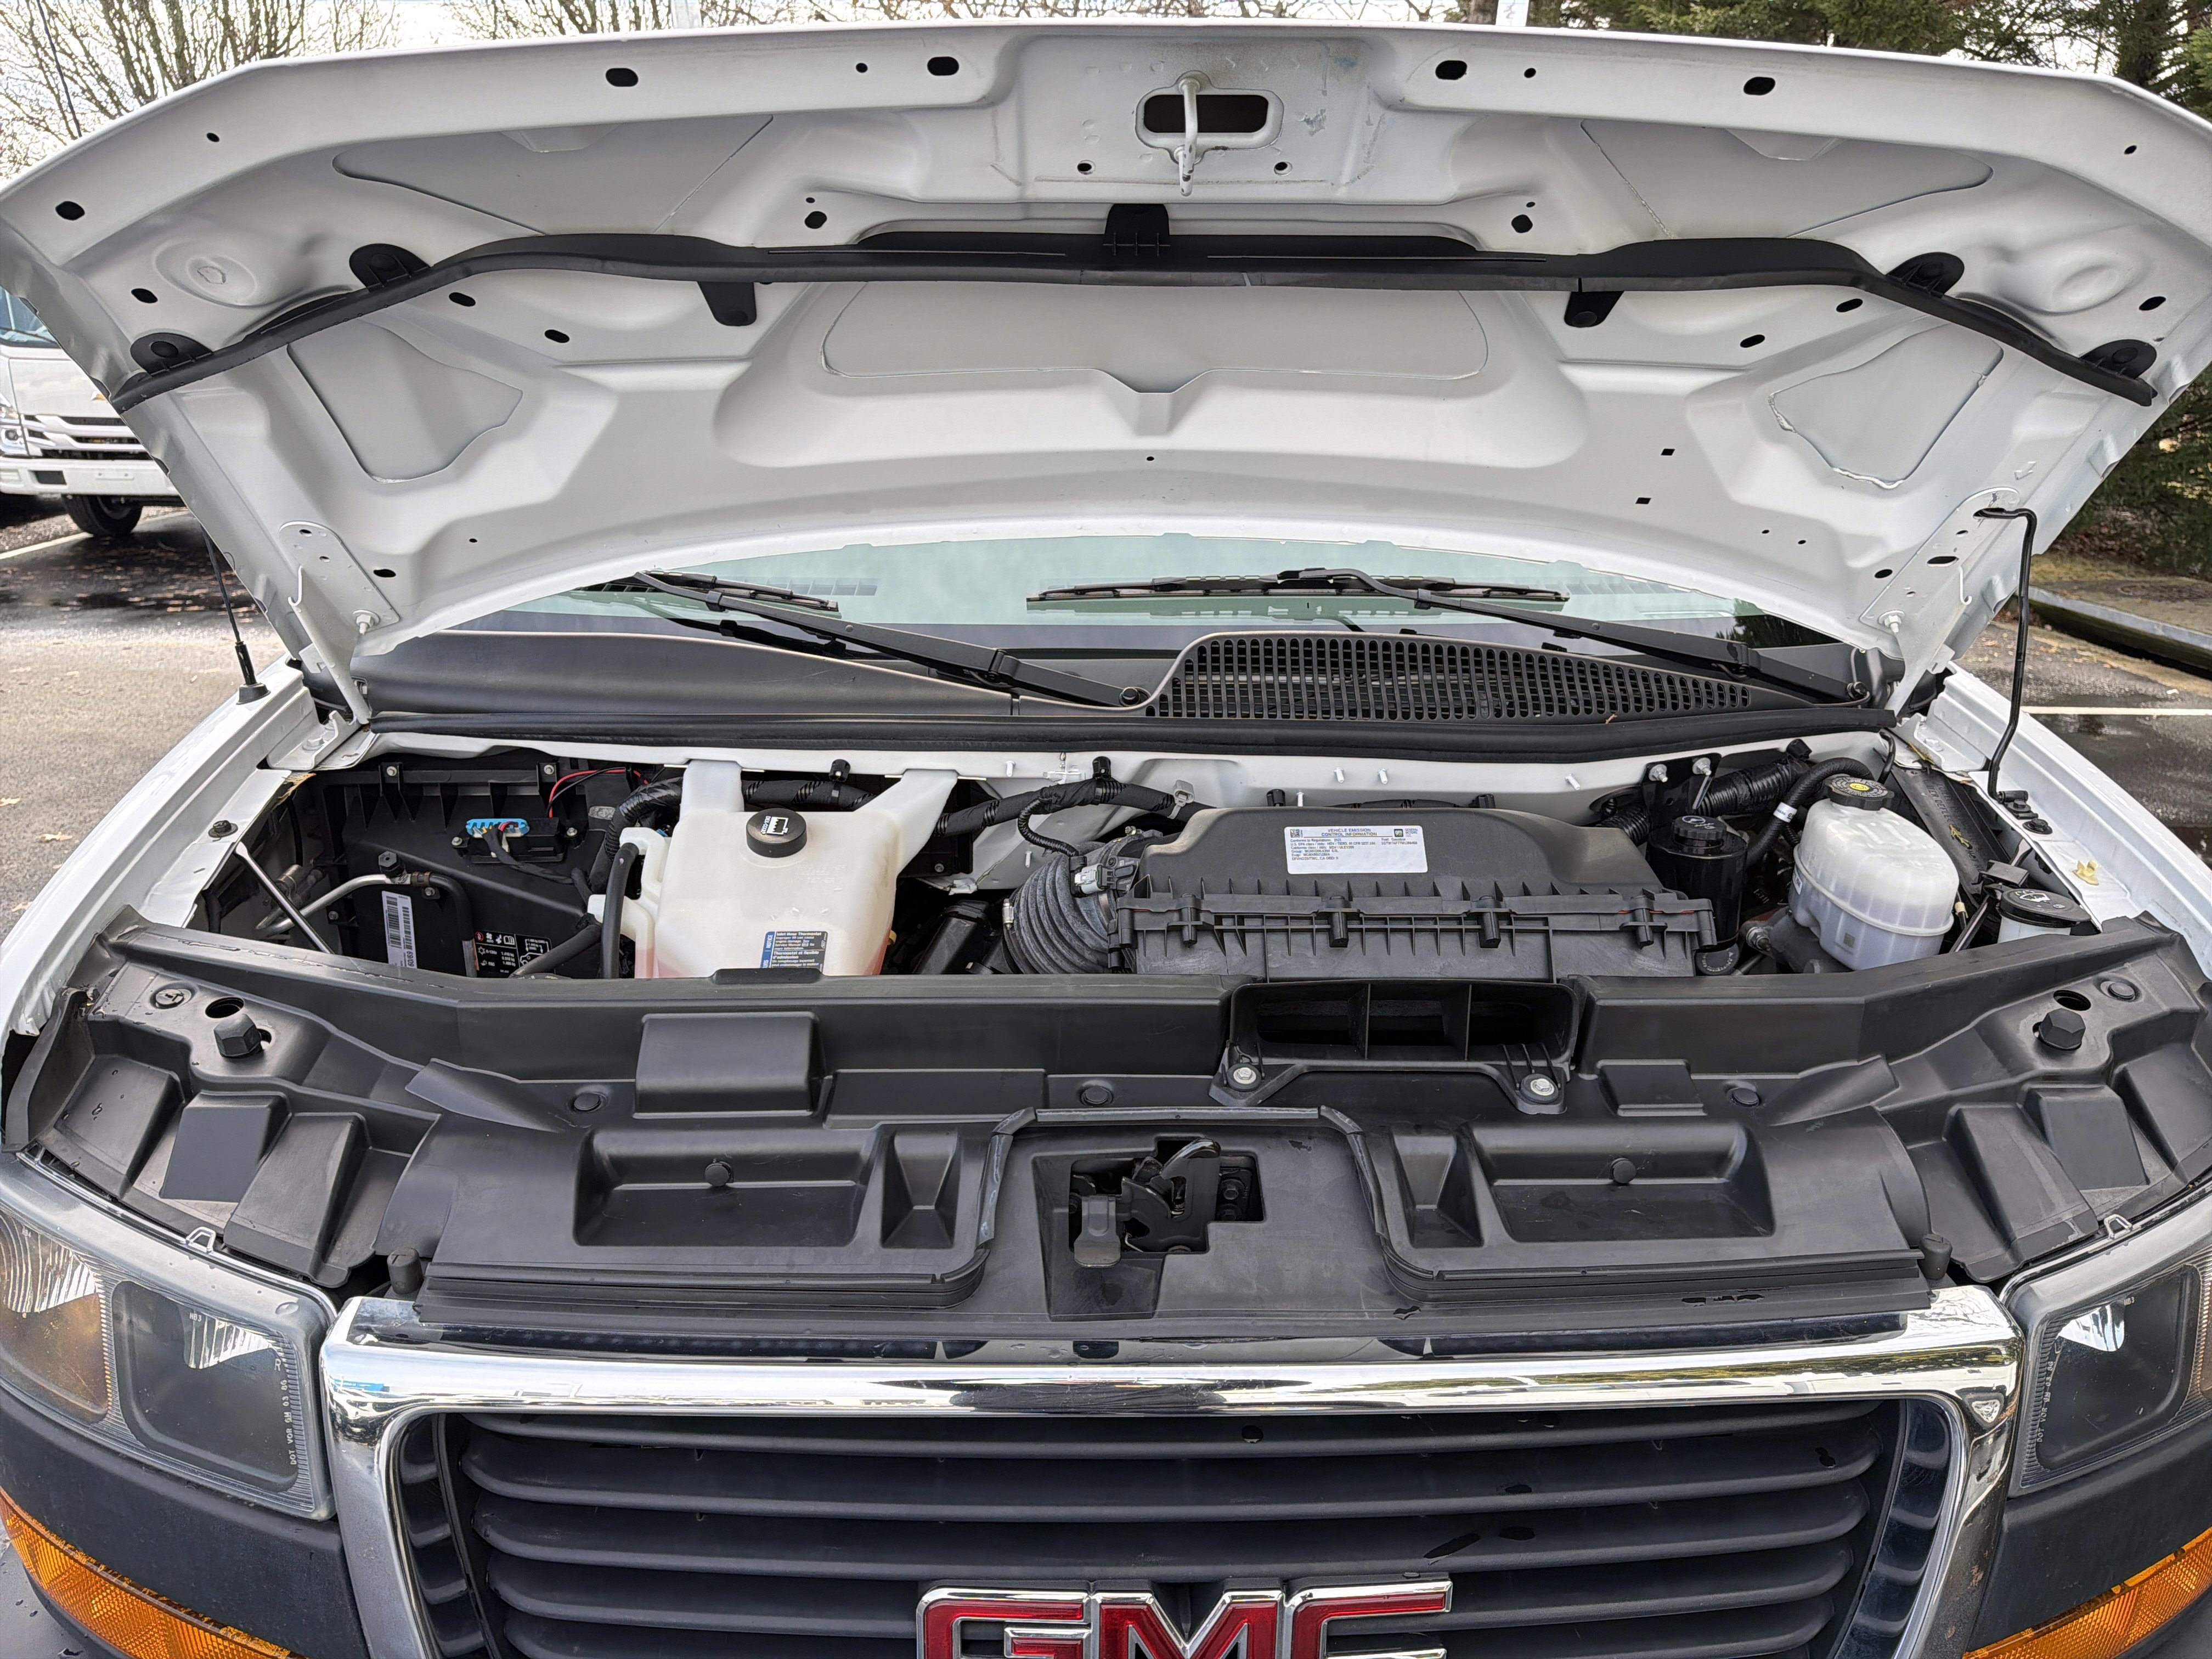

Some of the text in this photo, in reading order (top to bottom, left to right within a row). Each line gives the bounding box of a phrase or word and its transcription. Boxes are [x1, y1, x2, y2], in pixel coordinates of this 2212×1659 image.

[189, 1312, 202, 1322] HB3
[274, 1358, 281, 1372] R
[282, 1396, 289, 1407] 03
[284, 1411, 292, 1423] GM
[2040, 1407, 2048, 1422] VOR
[2036, 1428, 2045, 1443] DOT
[289, 1449, 297, 1465] DOT
[916, 1579, 1453, 1659] GMC
